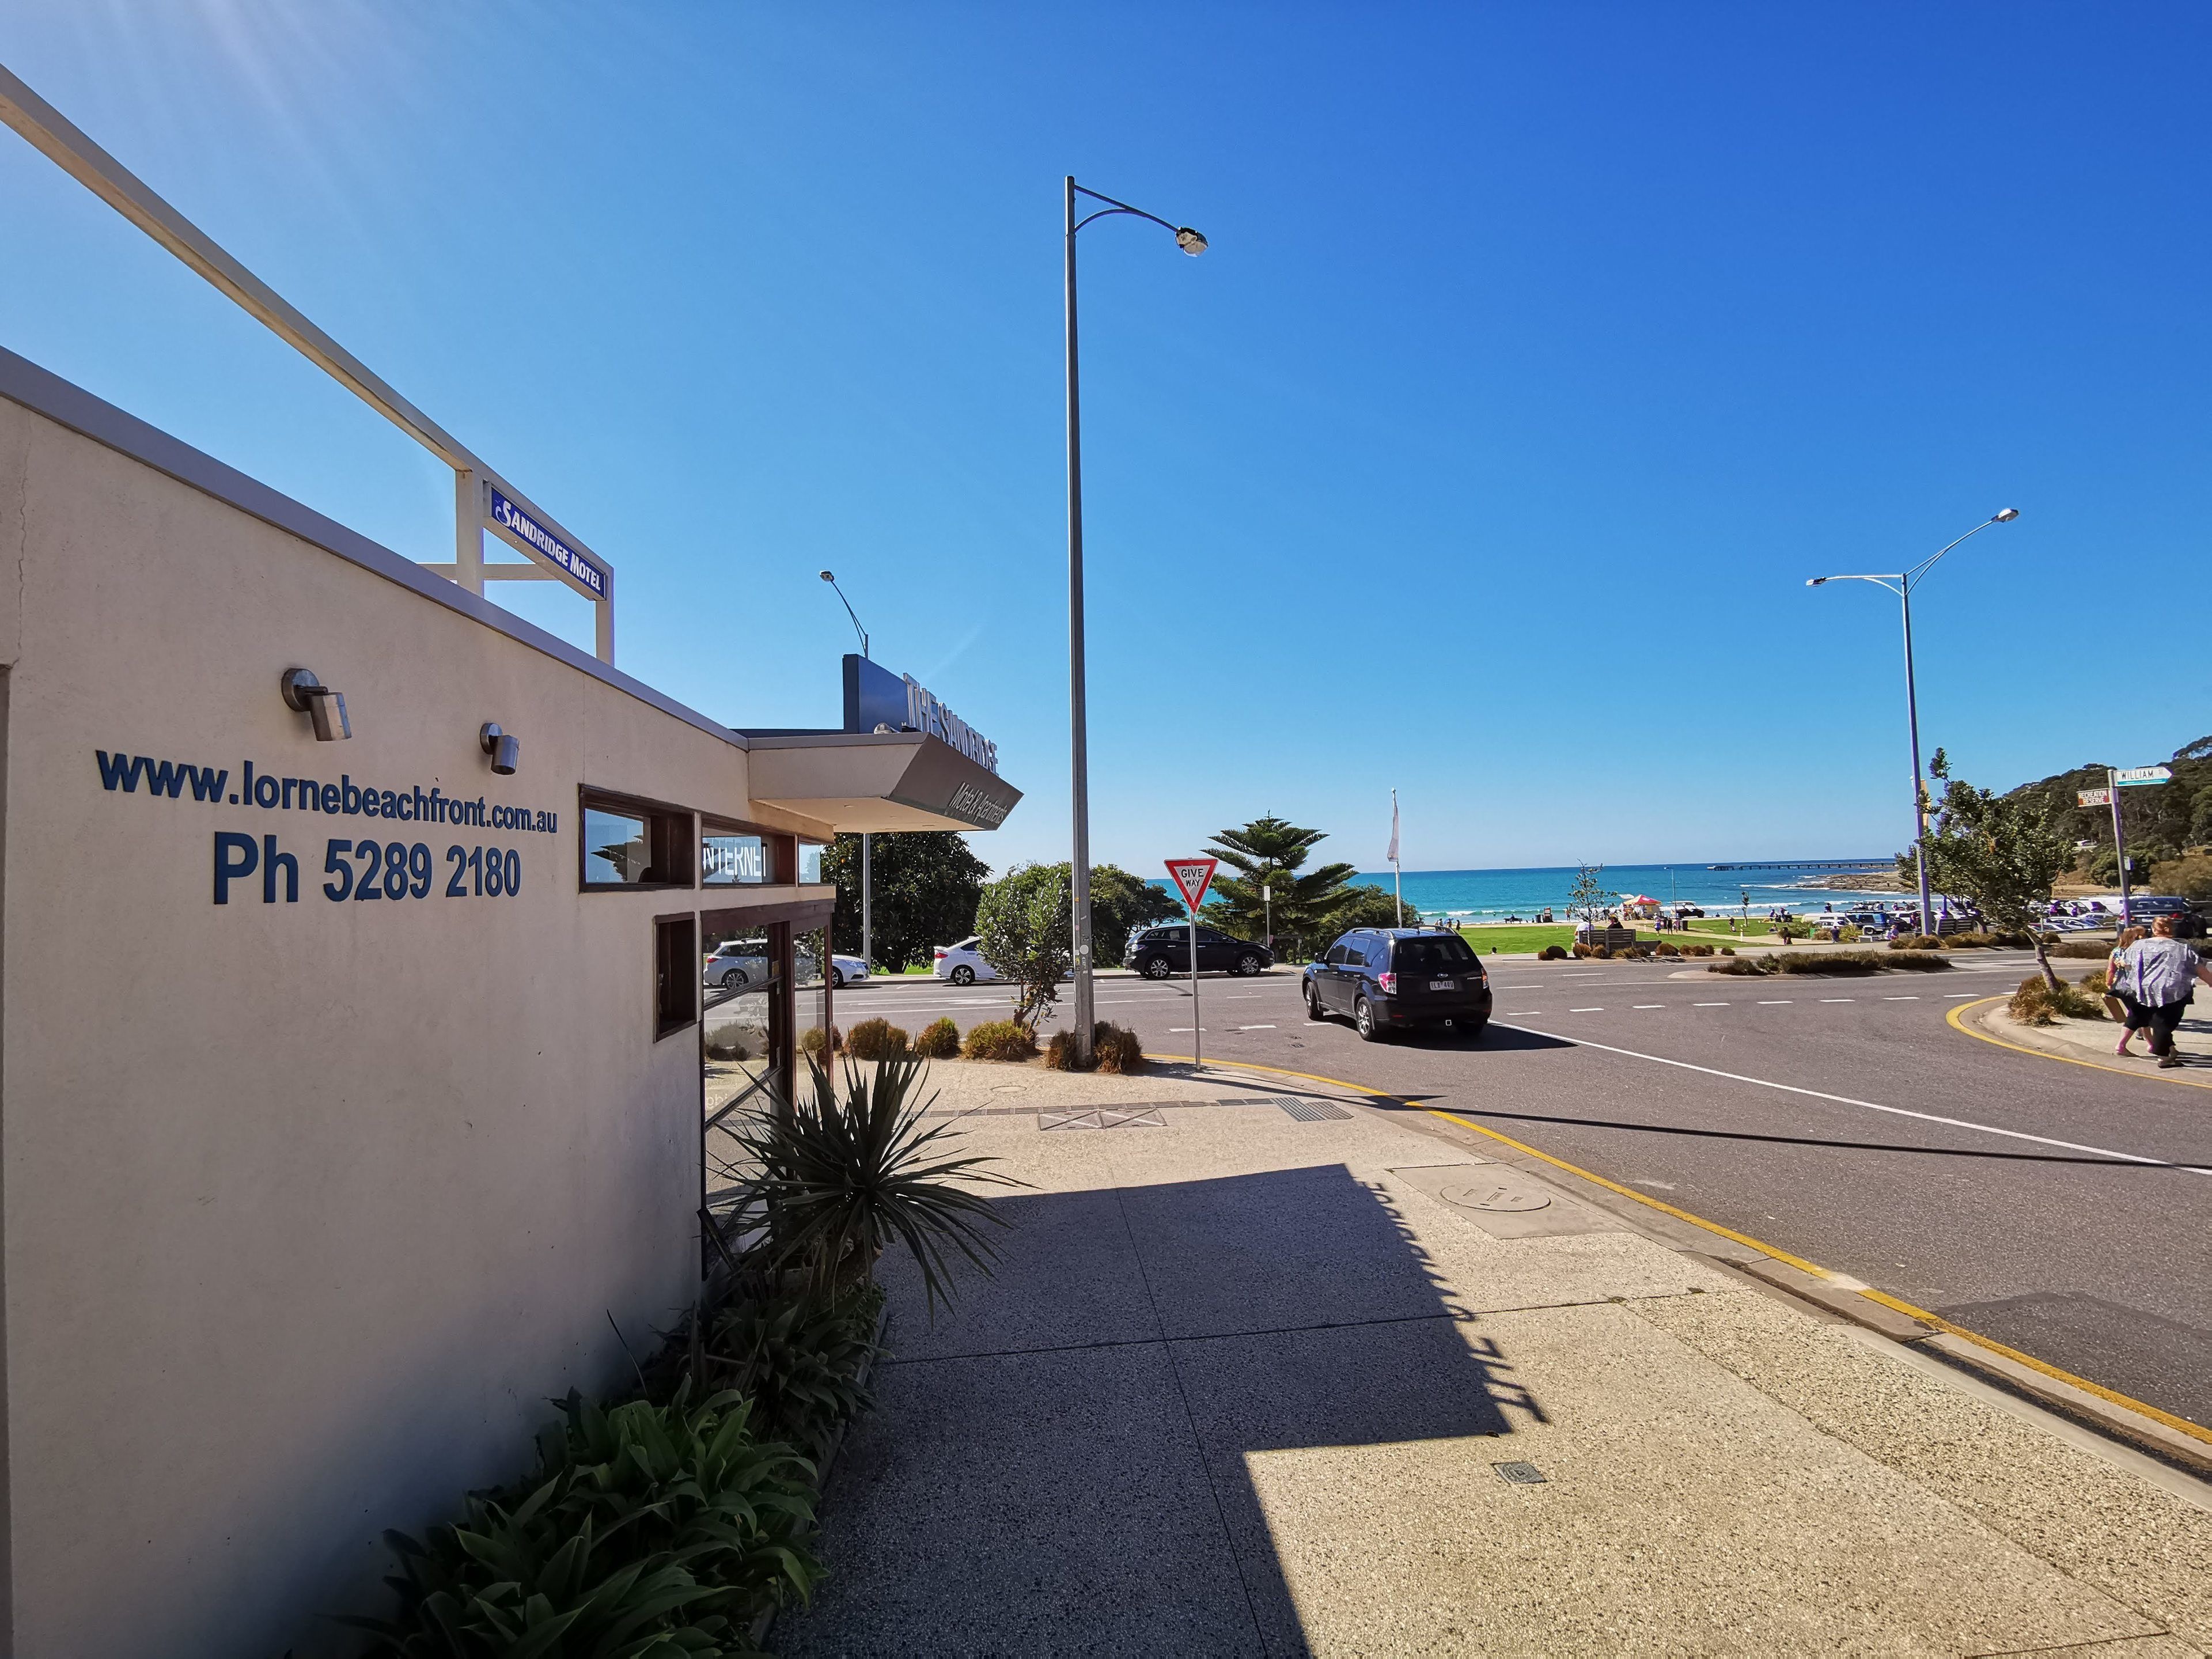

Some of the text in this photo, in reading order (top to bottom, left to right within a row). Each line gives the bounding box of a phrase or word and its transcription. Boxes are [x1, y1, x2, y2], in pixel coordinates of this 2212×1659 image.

[496, 500, 601, 591] SANDRIDGE MOTEL
[2122, 770, 2154, 779] WILLIAM
[95, 749, 558, 833] www.lornebeachfront.com.au
[949, 782, 979, 813] Motel
[2078, 790, 2107, 799] RECREATION
[2083, 797, 2105, 805] RESERVE
[214, 831, 521, 905] Ph 5289 2180
[703, 843, 767, 877] NTERNET
[1181, 869, 1204, 878] GIVE
[1185, 879, 1200, 887] WAY
